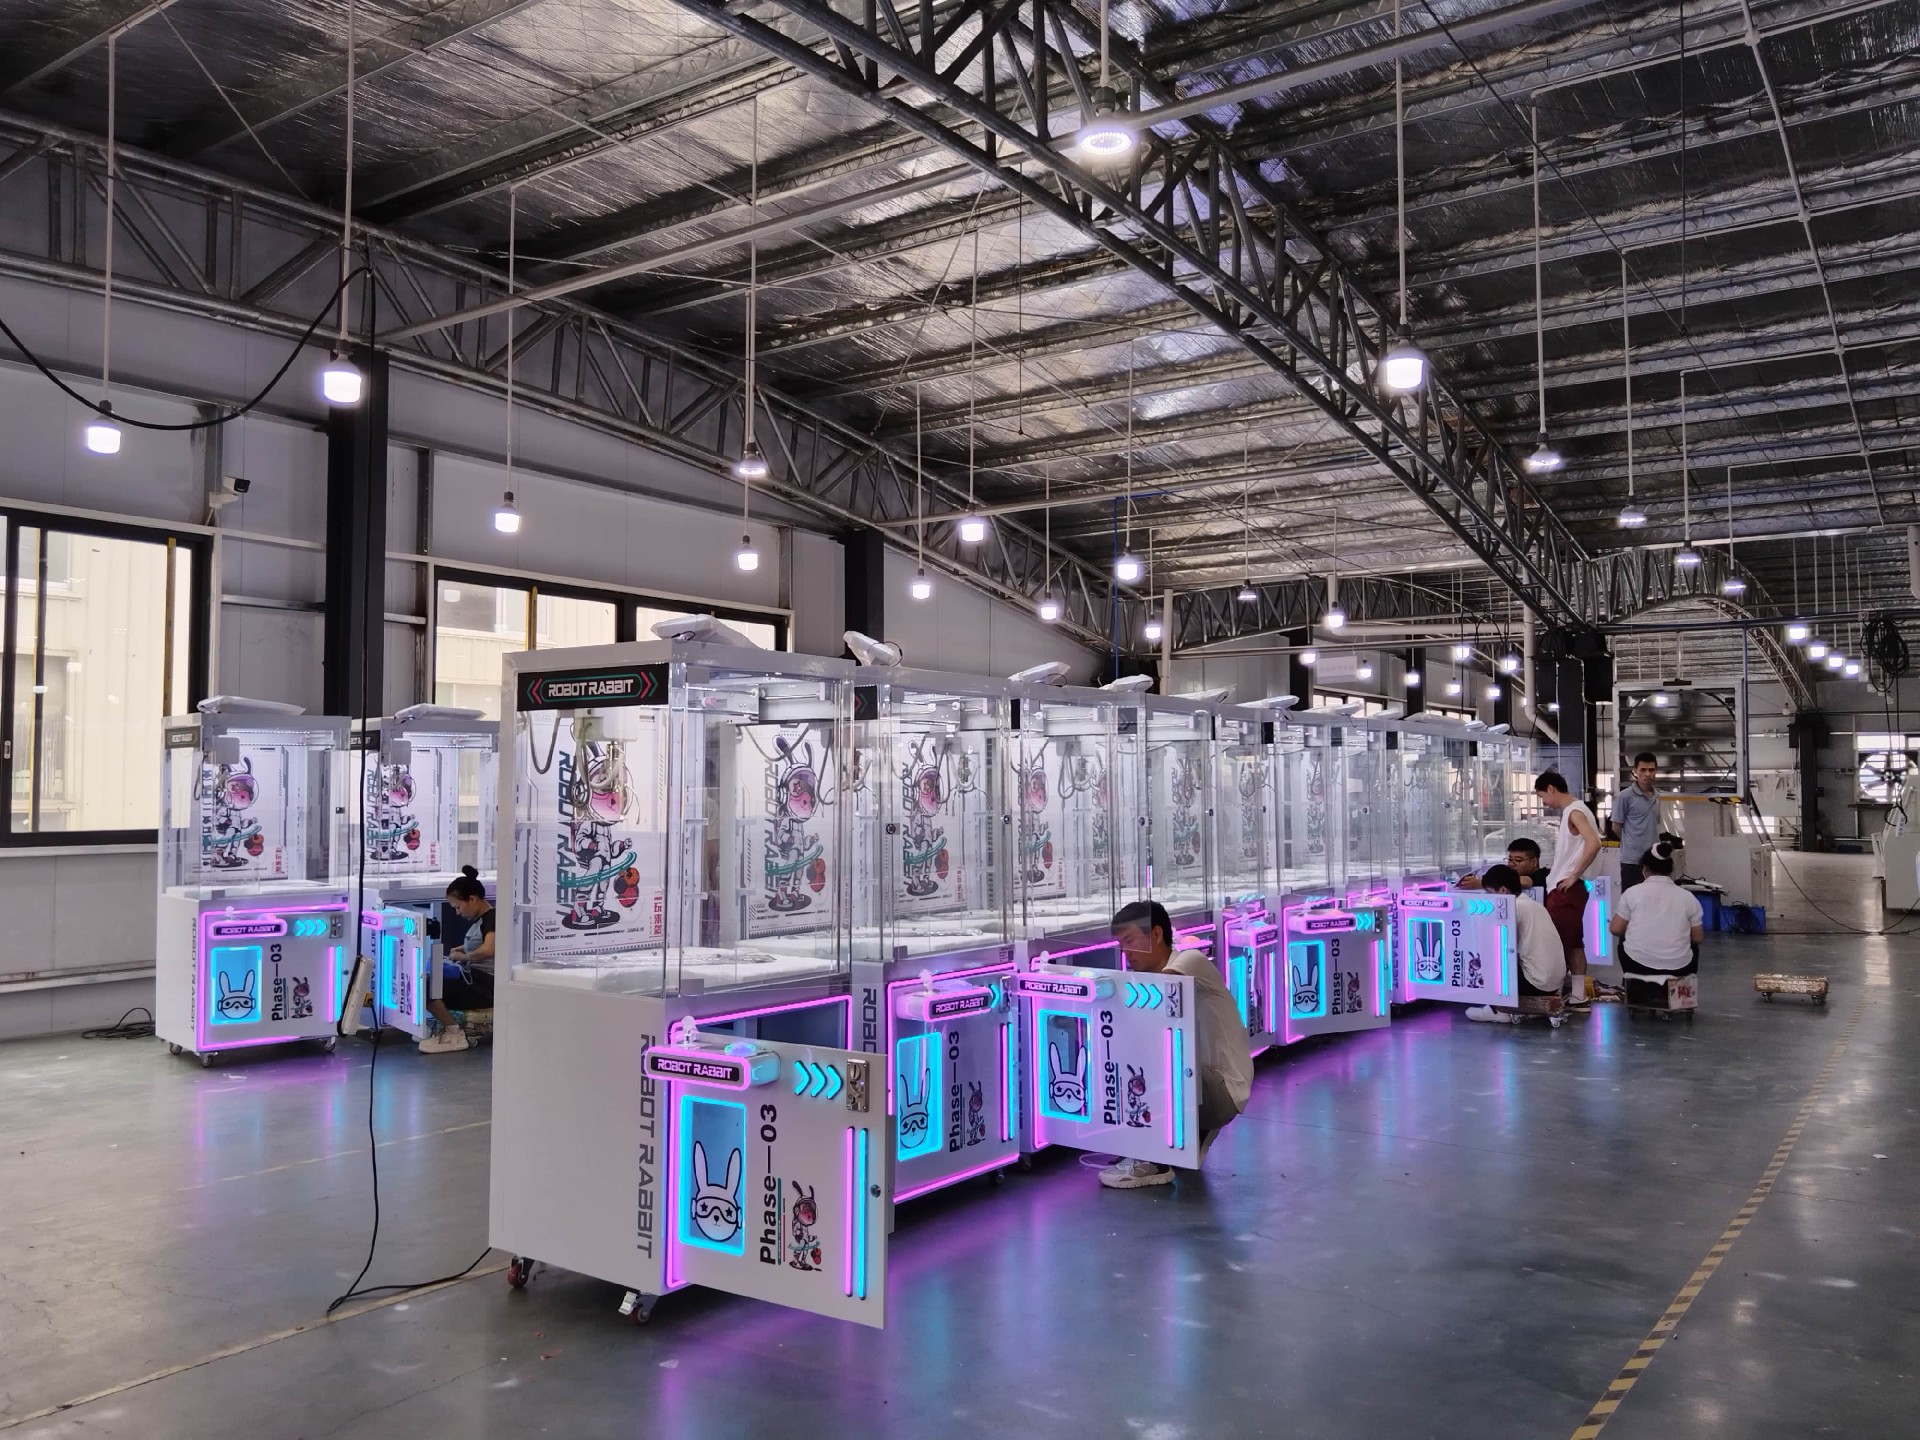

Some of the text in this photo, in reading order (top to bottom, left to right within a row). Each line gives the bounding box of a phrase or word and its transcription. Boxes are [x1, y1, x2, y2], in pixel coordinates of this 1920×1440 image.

[548, 679, 634, 697] ROBOT RABBIT
[1025, 980, 1083, 995] ROBOT RABBIT
[935, 996, 985, 1013] ROBOT RABBIT
[862, 988, 877, 1054] ROBO
[657, 1057, 733, 1080] ROBOT RABBIT
[637, 1034, 656, 1259] RBOT RABBIT
